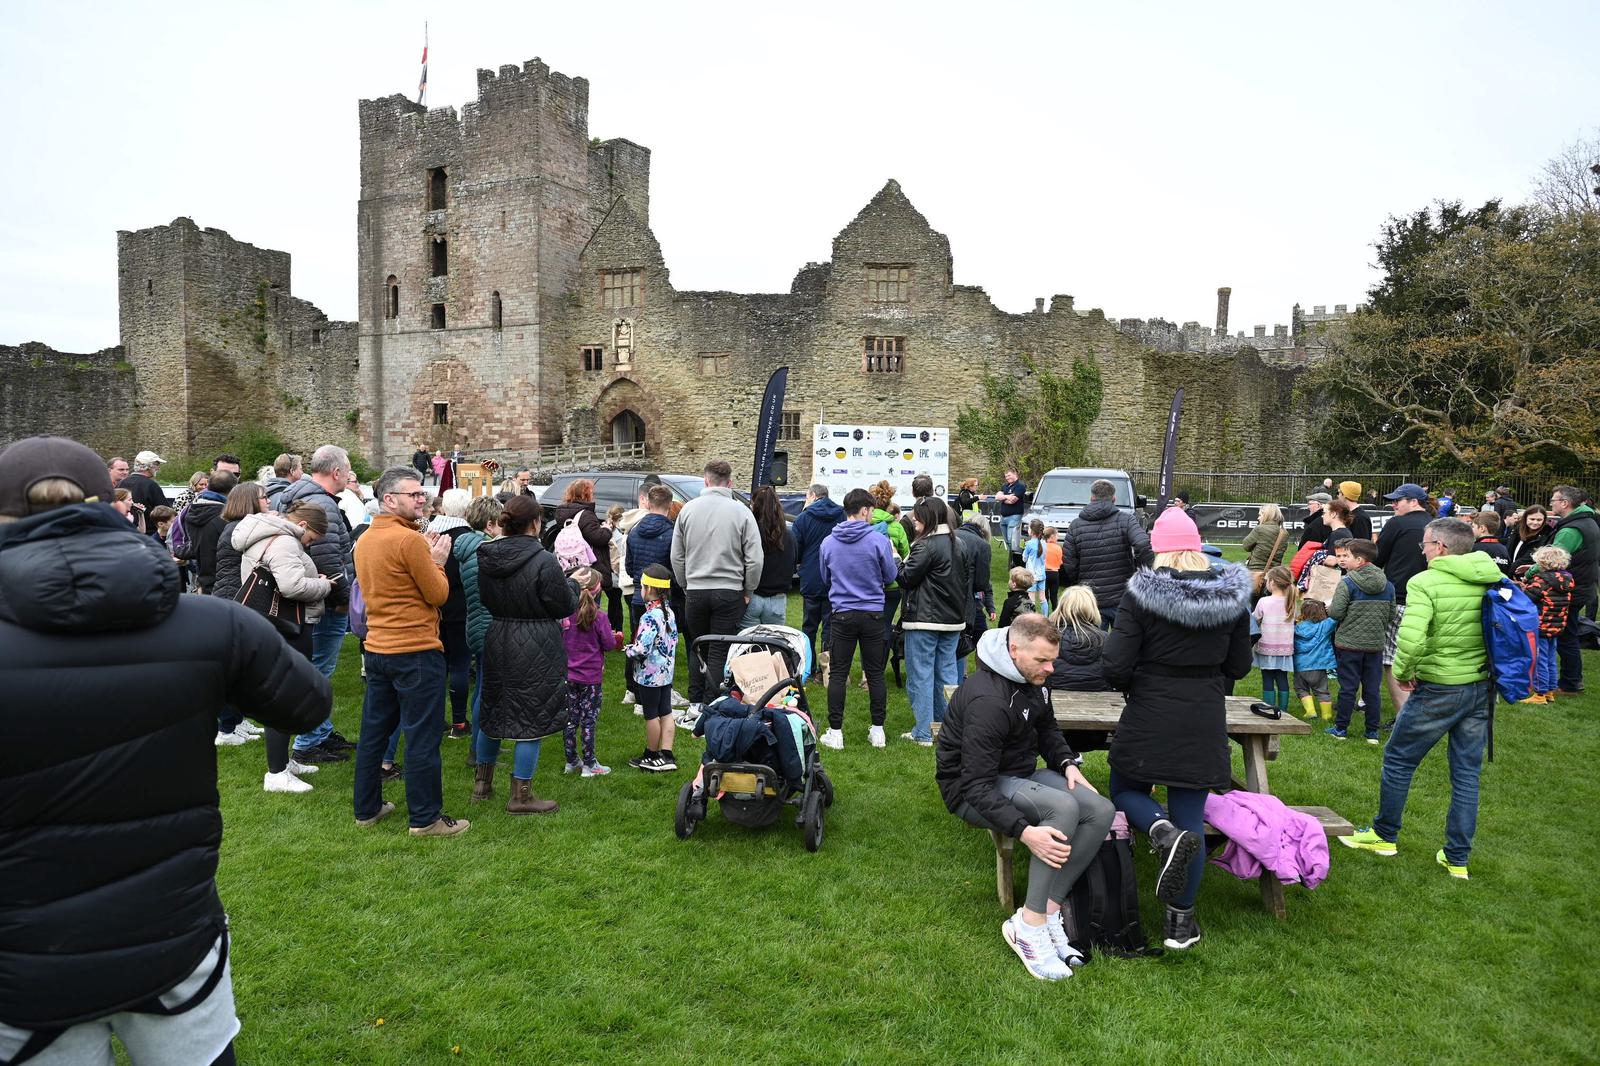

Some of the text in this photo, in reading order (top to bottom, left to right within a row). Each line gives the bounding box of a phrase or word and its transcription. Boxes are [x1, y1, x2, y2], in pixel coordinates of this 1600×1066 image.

[852, 447, 863, 457] EPIC
[919, 448, 930, 459] EPIC
[1216, 520, 1305, 530] DEFEER
